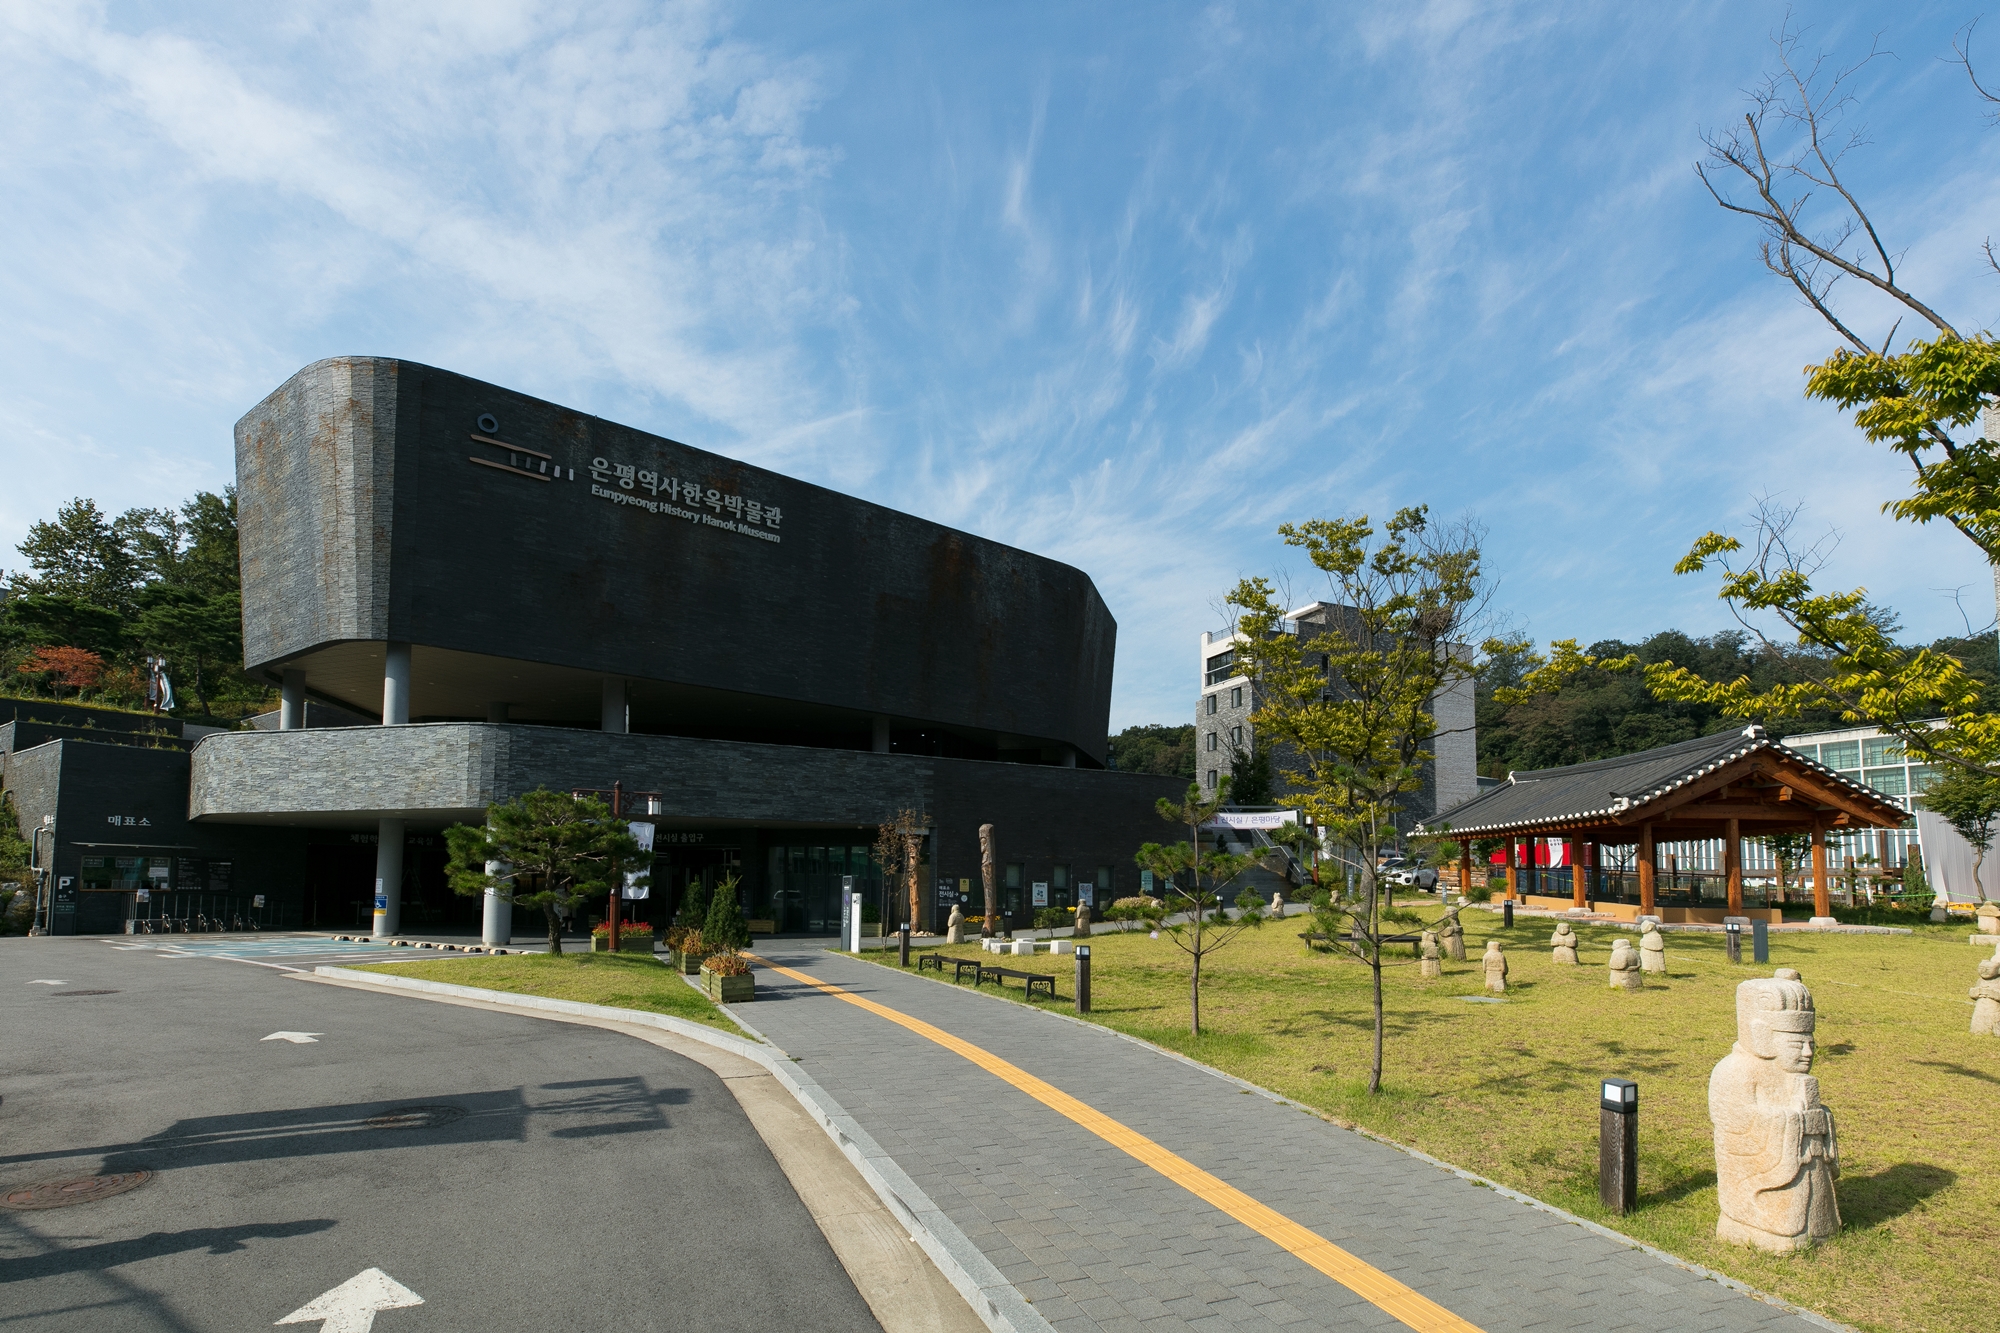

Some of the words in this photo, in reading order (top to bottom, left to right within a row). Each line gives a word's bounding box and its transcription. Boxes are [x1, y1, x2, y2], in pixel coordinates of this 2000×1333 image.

[588, 457, 783, 529] 은평역사한옥박물관
[591, 484, 658, 514] Eunpyeong
[659, 502, 701, 524] History
[702, 513, 737, 532] Hanok
[737, 523, 781, 543] Museum
[107, 815, 152, 826] 매표소
[1221, 816, 1243, 824] 전시실
[1251, 815, 1281, 824] 은평마당
[407, 836, 434, 846] 교육실
[655, 833, 679, 843] 전시실
[680, 833, 705, 843] 출입구
[58, 877, 71, 890] P
[938, 890, 954, 898] 전시실
